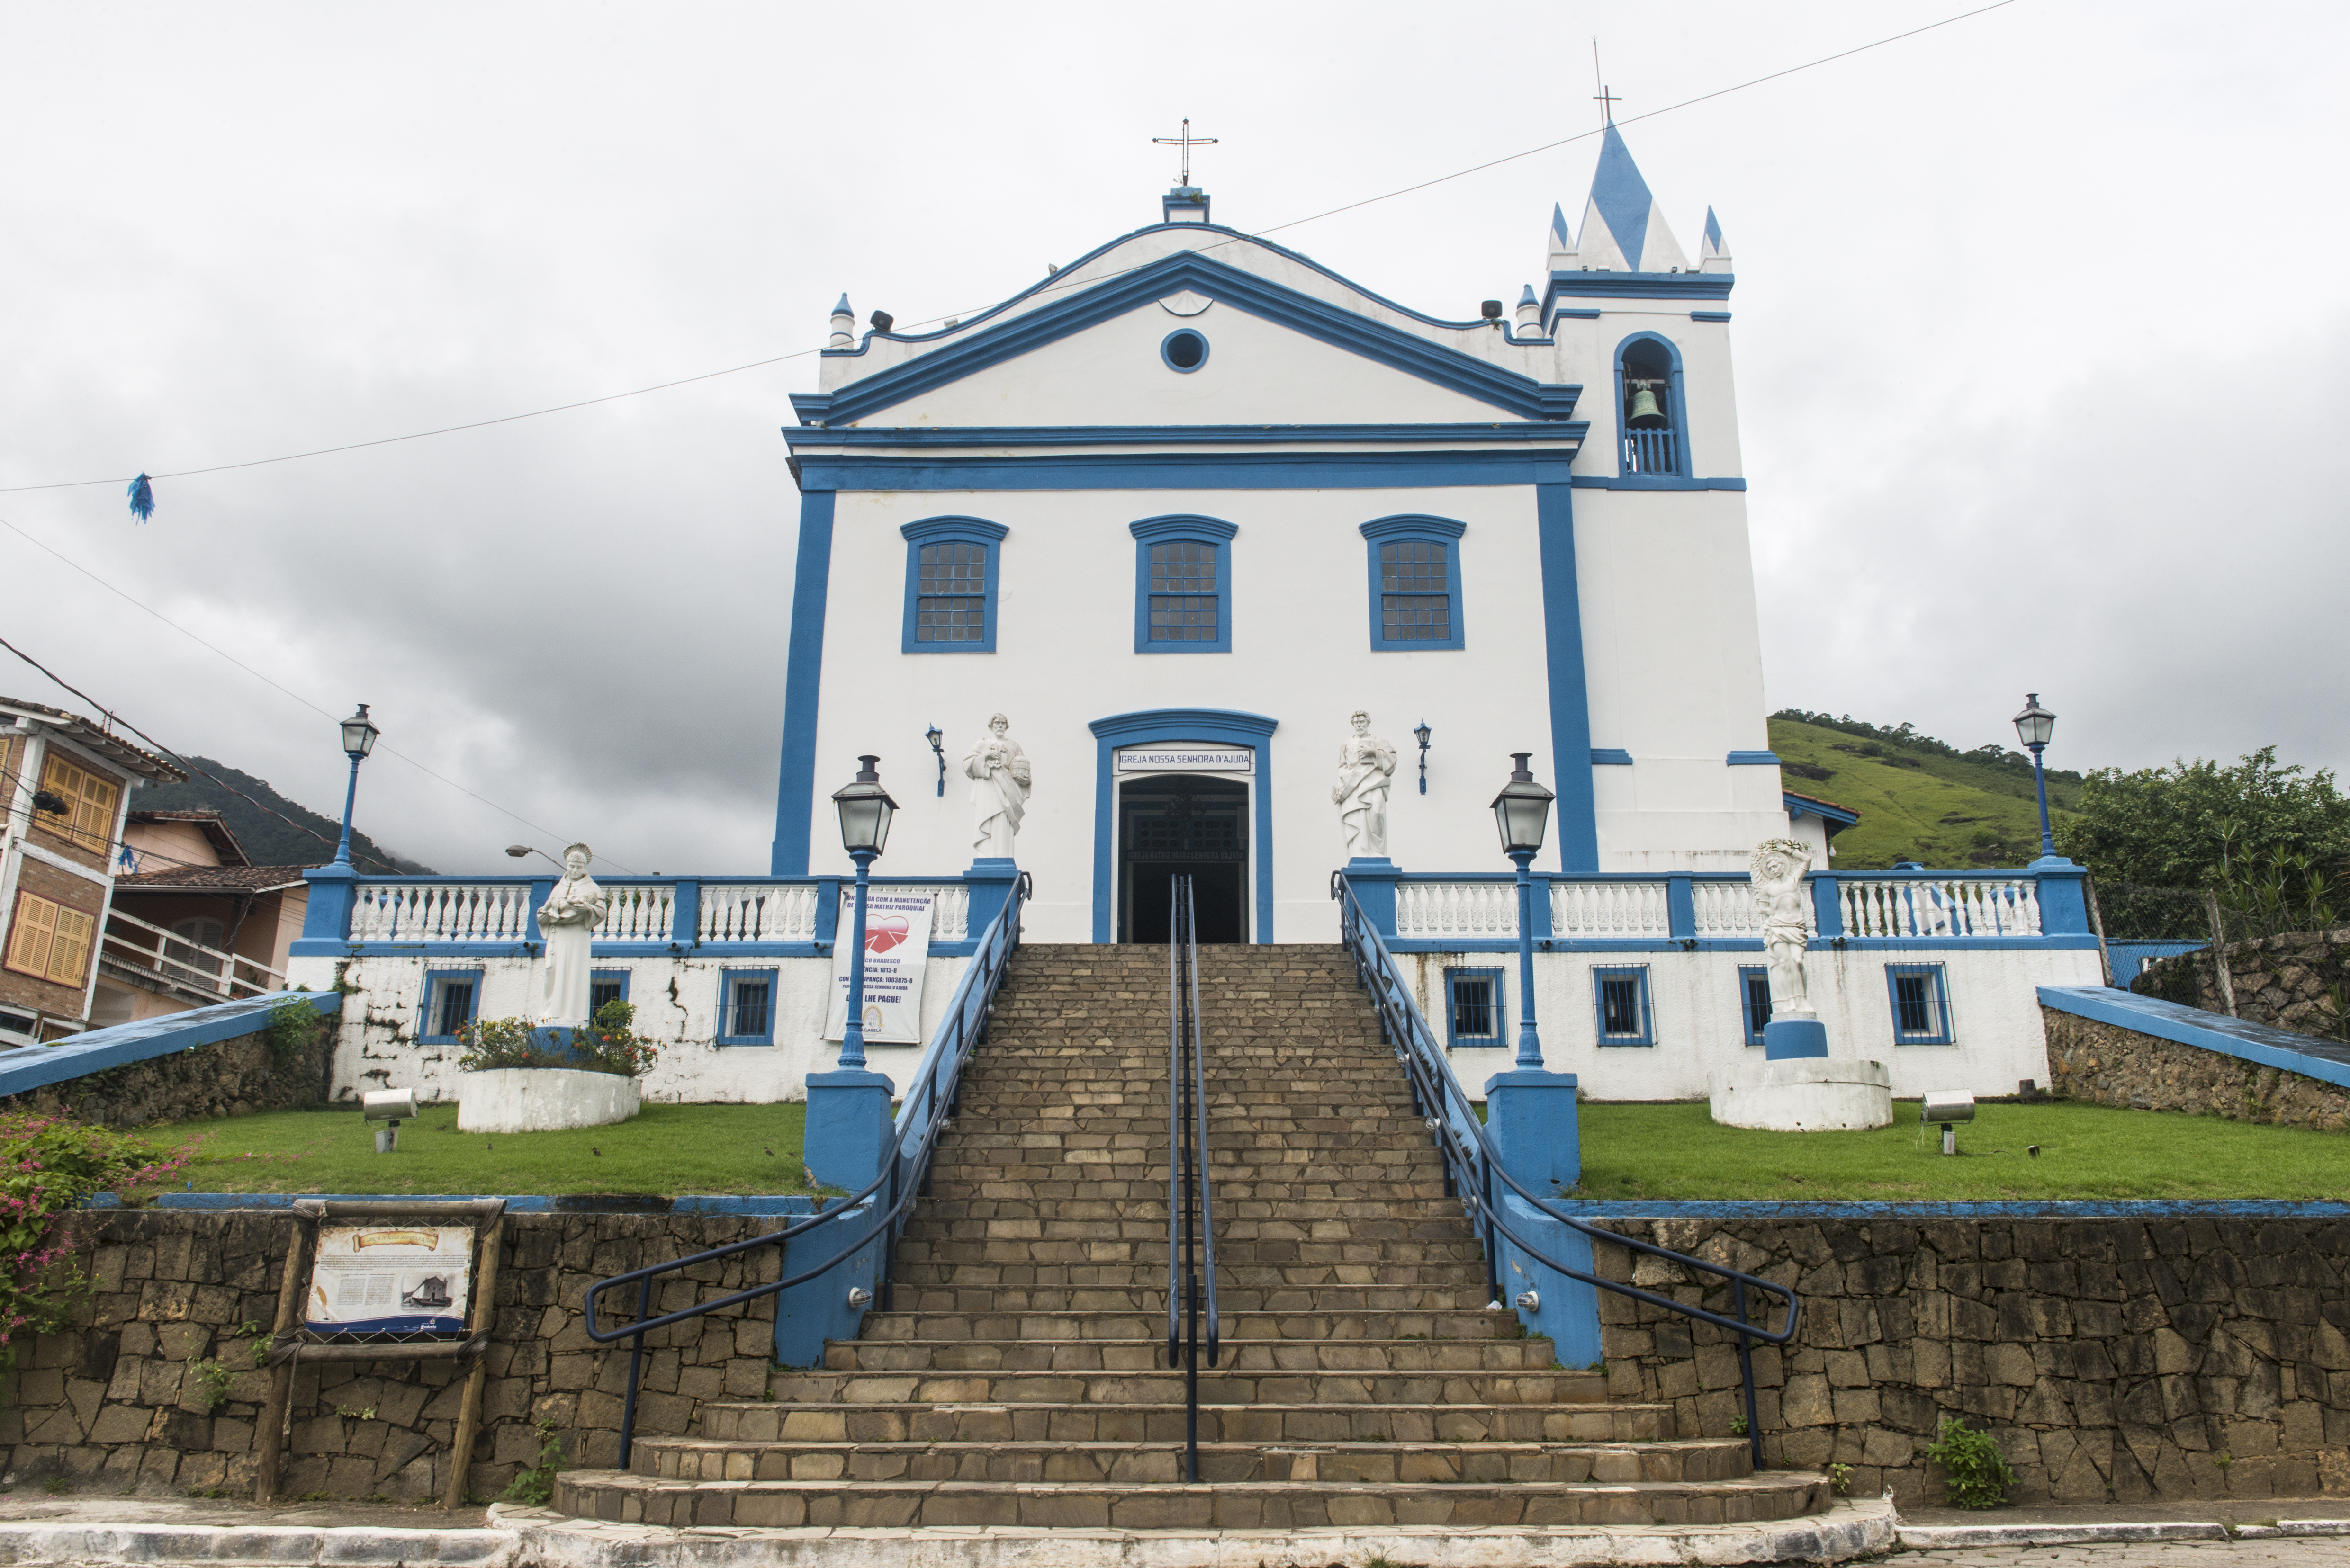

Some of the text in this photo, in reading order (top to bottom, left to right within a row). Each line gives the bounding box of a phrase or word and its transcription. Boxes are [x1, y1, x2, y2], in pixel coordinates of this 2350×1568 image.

[1216, 755, 1249, 763] D'AJUDA
[1127, 851, 1149, 859] IGREJA
[1150, 851, 1170, 859] MATRIZ
[1191, 851, 1219, 860] SENHORA
[894, 897, 931, 905] MANUTENÇÃO
